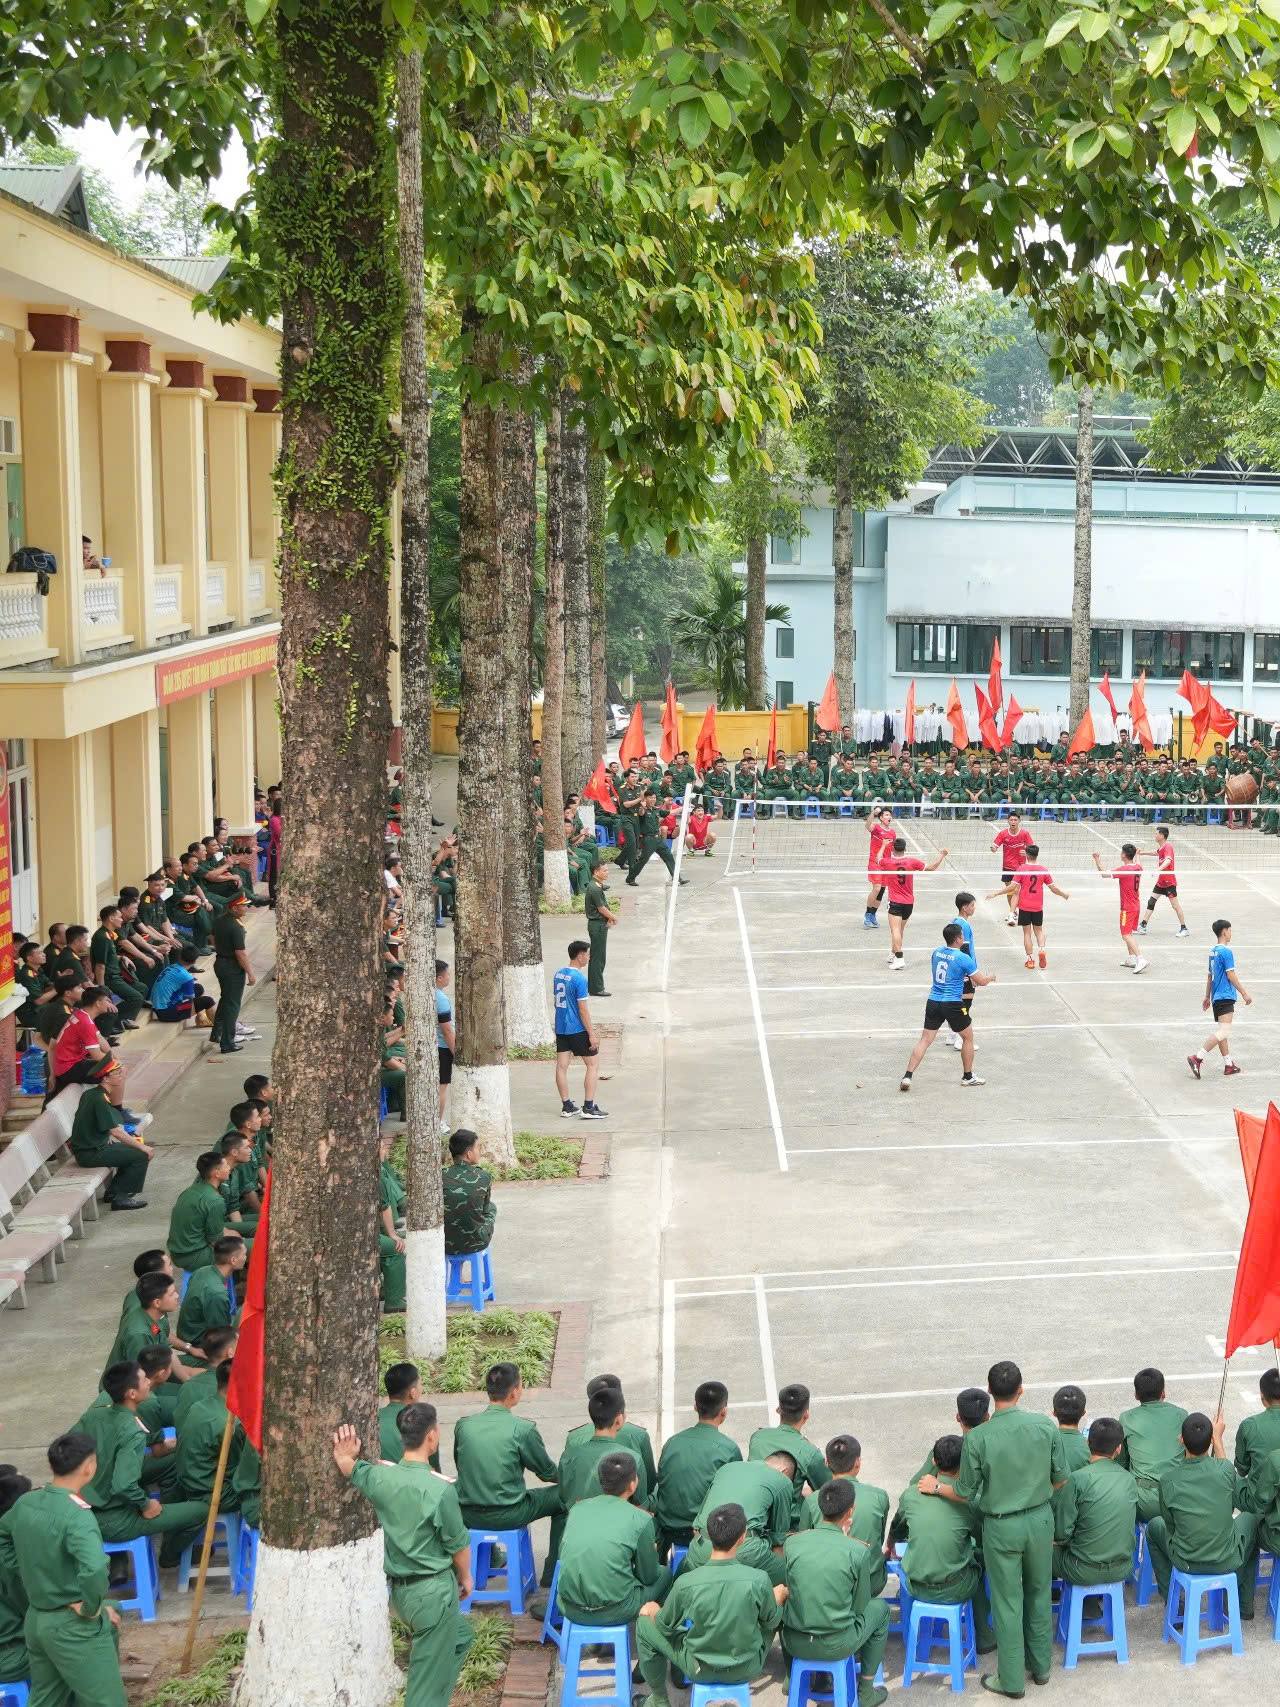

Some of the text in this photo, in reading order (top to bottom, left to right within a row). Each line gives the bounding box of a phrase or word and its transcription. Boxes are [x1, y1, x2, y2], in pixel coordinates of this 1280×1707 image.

[1028, 874, 1038, 894] 2
[936, 961, 948, 983] 6
[556, 982, 567, 1009] 2
